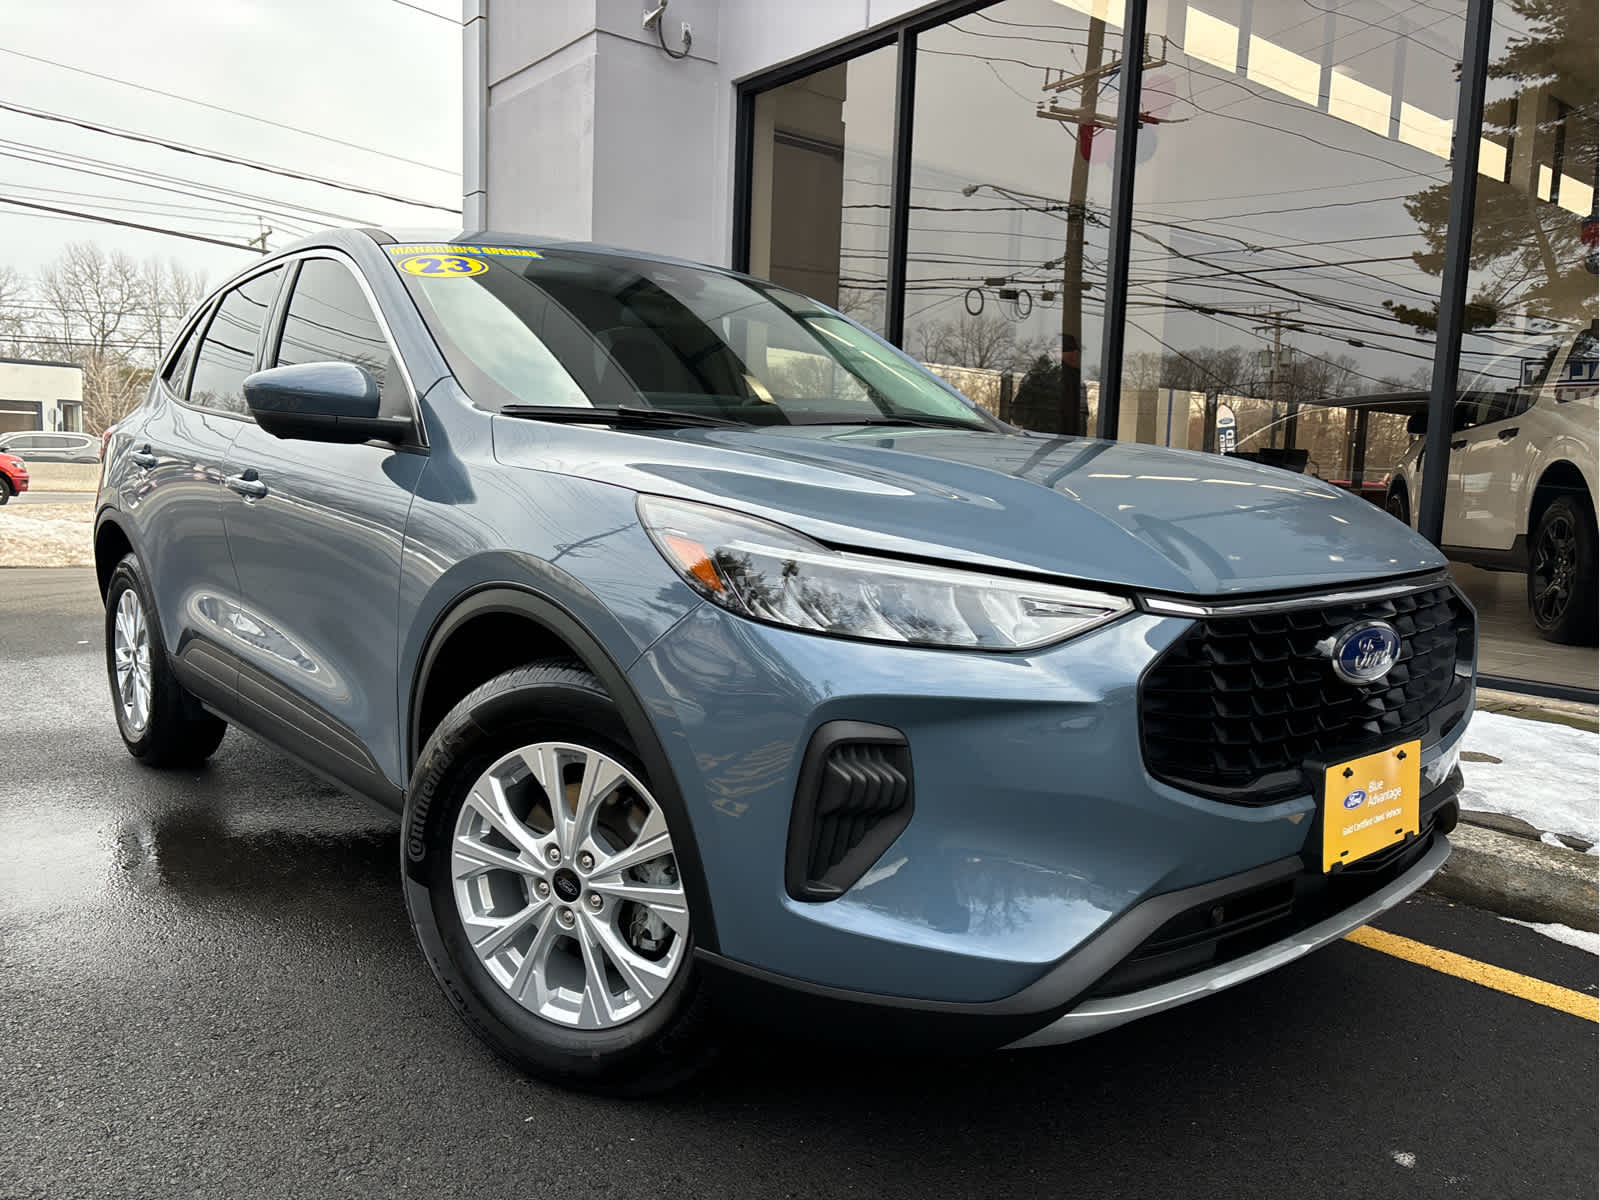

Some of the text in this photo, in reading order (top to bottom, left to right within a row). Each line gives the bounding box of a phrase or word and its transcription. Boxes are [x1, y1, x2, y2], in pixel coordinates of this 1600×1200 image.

[481, 247, 542, 257] SPECIAL
[416, 257, 472, 273] 23
[1368, 779, 1384, 792] Blue
[1368, 786, 1402, 807] Advantage
